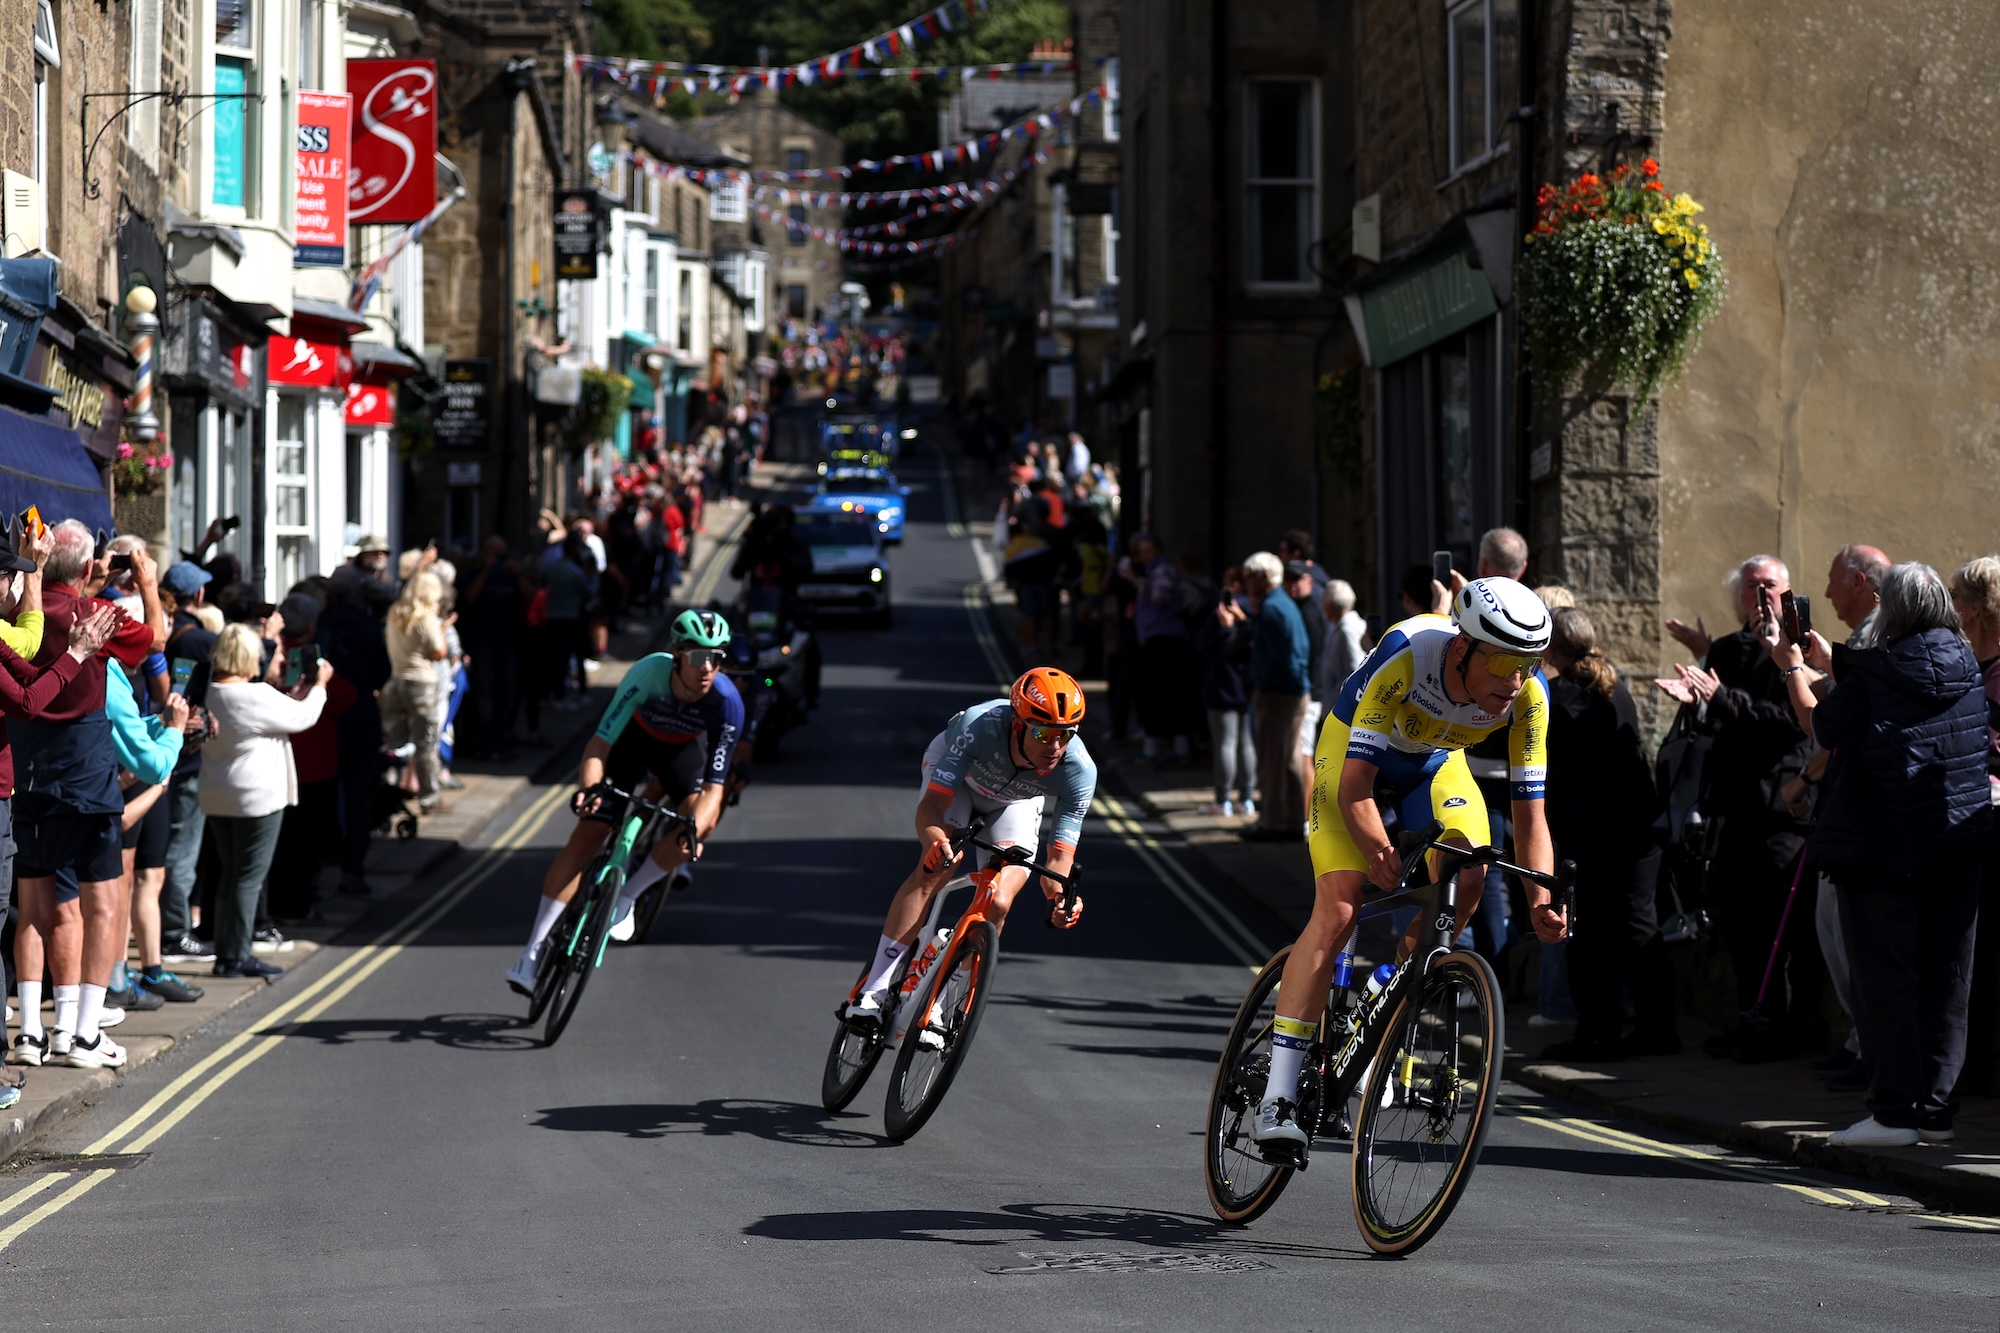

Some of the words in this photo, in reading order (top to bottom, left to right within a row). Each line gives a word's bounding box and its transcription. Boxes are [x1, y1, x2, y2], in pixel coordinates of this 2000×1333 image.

[1474, 580, 1502, 615] RUDY
[1372, 684, 1385, 702] Team
[1380, 678, 1404, 705] Flanders
[1416, 695, 1443, 717] baloise
[1471, 714, 1498, 722] CALLA
[711, 722, 738, 772] Adecco
[1336, 1026, 1365, 1079] eddy
[1368, 953, 1413, 1026] merckx
